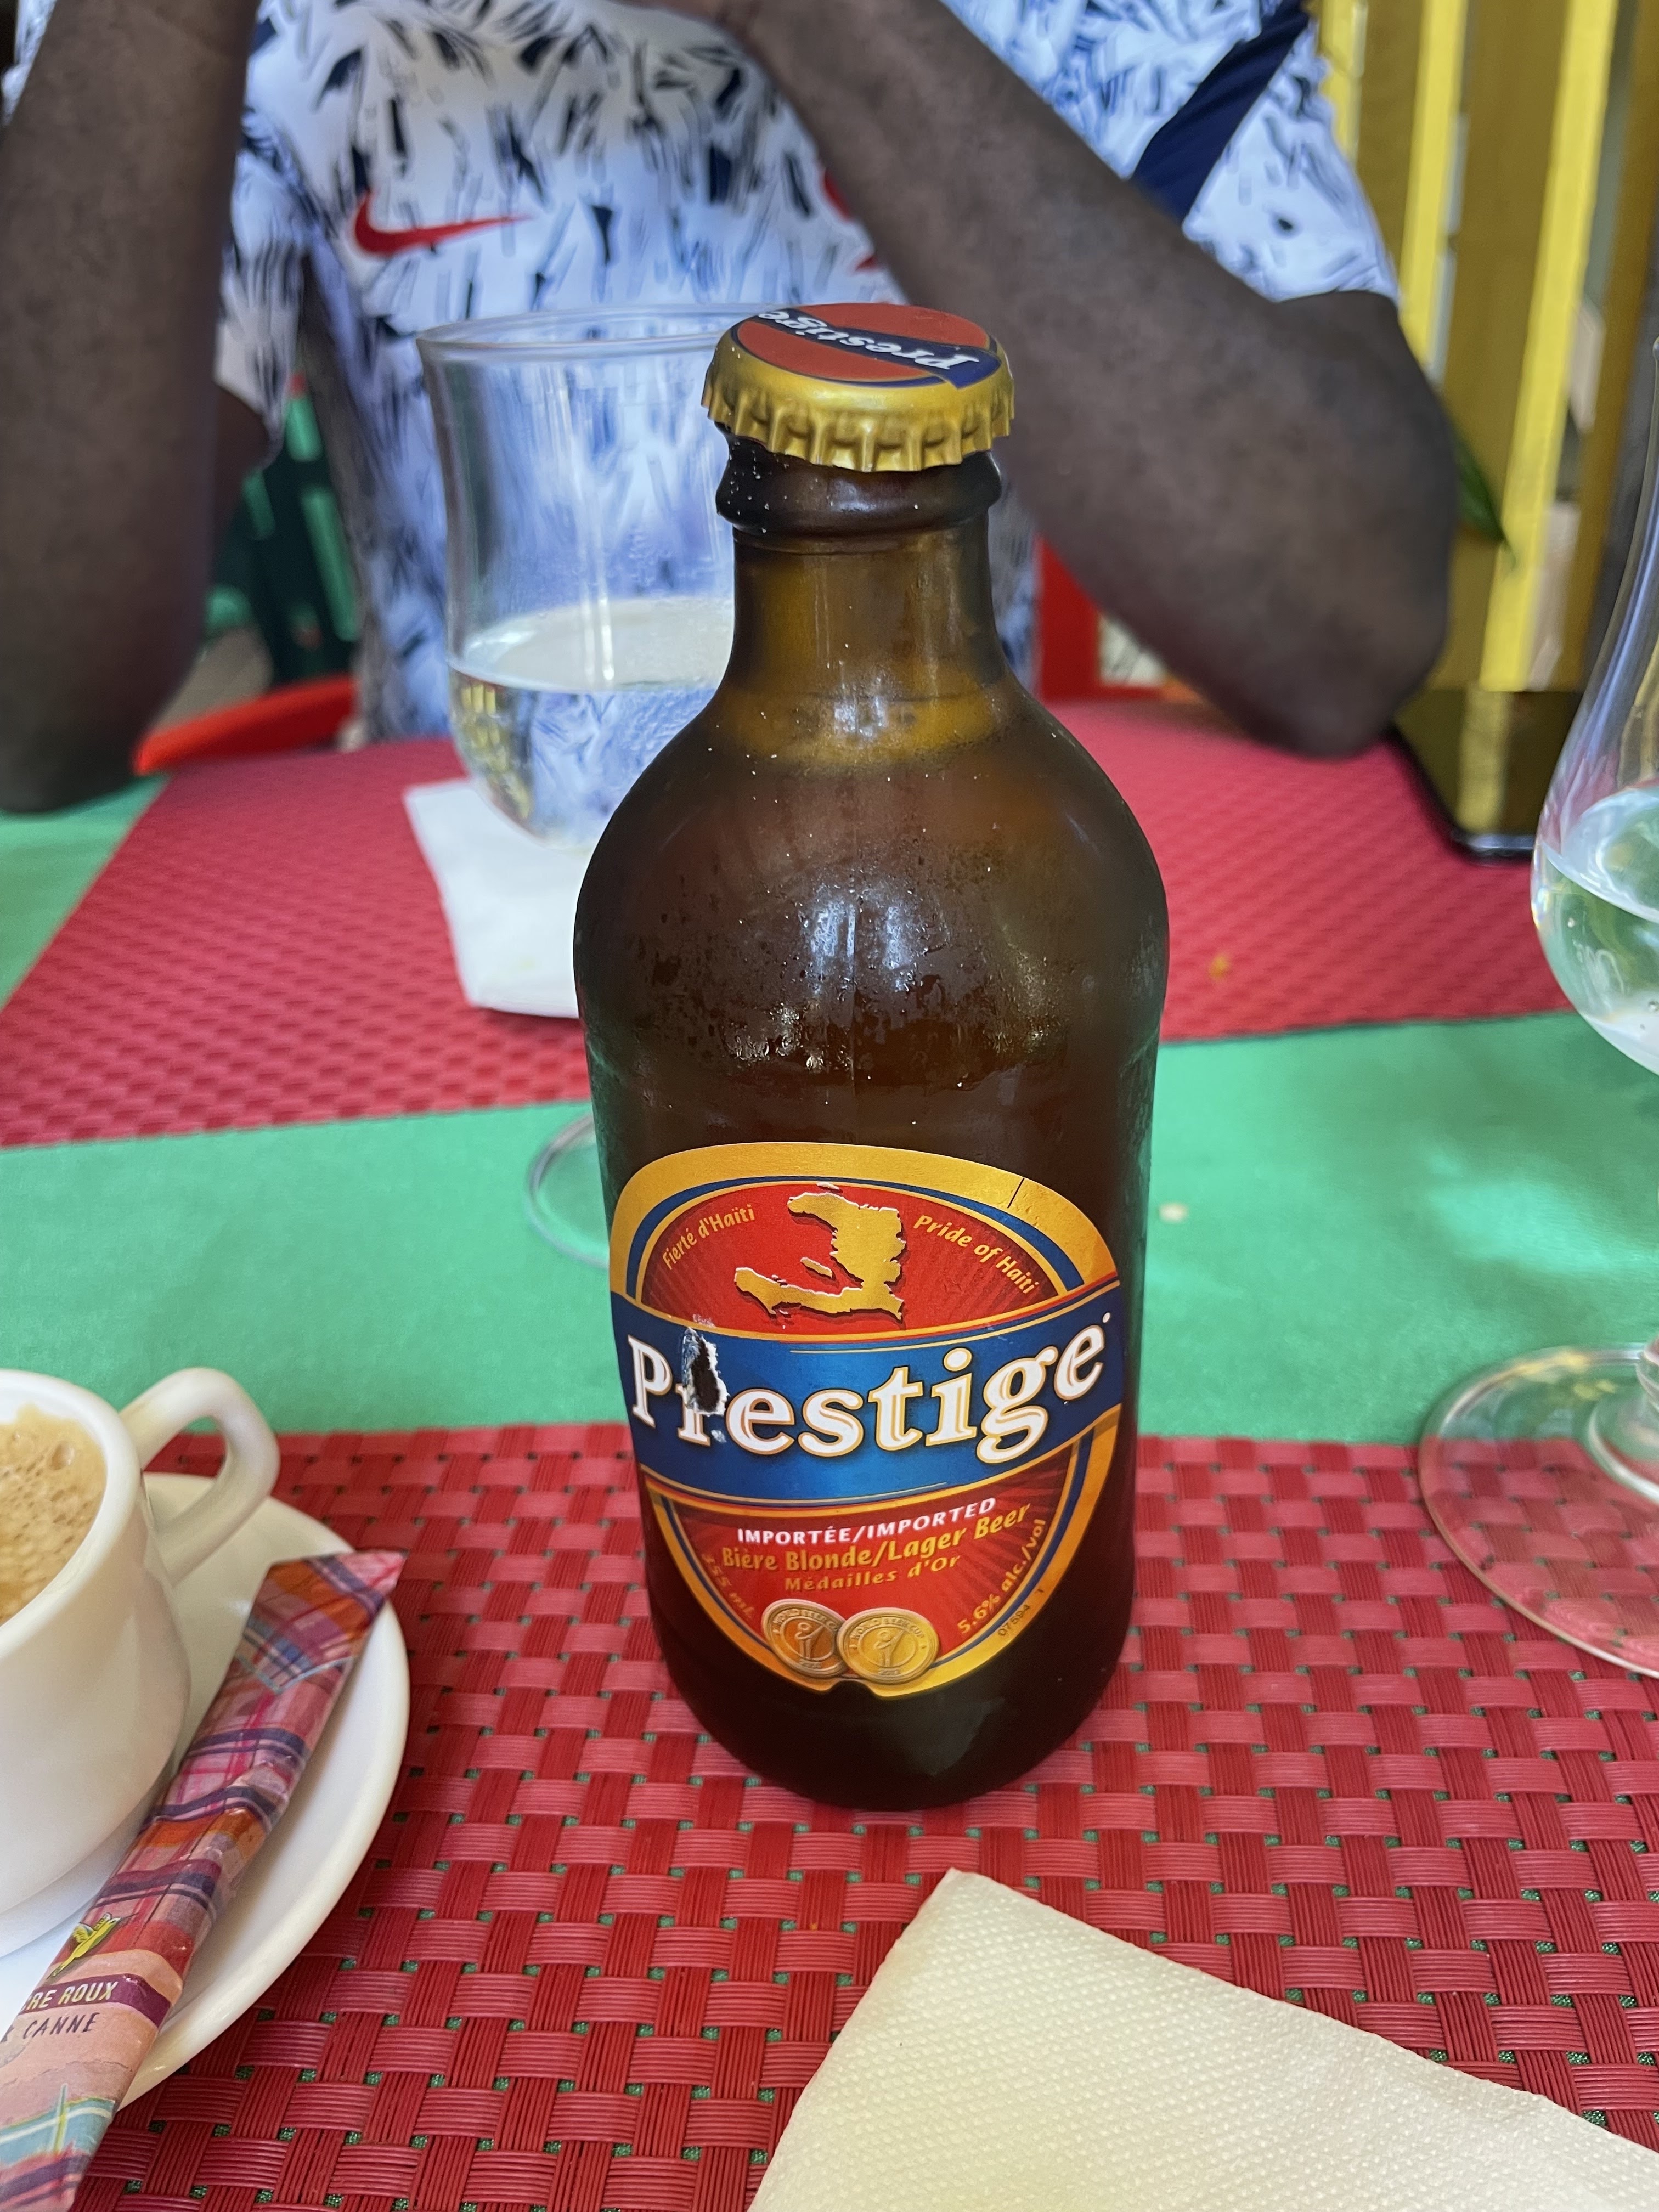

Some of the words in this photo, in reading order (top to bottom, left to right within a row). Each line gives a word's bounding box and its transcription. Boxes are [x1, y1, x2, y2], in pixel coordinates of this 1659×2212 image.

[758, 311, 979, 370] Prestige
[662, 1228, 697, 1270] Fierté
[698, 1204, 755, 1238] d'Haïti
[913, 1209, 973, 1248] Pride
[973, 1244, 1003, 1263] of
[995, 1256, 1040, 1294] Haiti
[722, 1547, 778, 1571] Bière
[785, 1527, 967, 1571] Blonde/Lager
[973, 1503, 1031, 1540] Beer
[737, 1497, 997, 1545] IMPORTÉE/IMPORTED
[785, 1570, 898, 1592] Médailles
[907, 1555, 960, 1578] d'Or
[957, 1593, 1001, 1634] 5.6%
[22, 1989, 58, 2011] RE
[57, 1981, 119, 2005] ROUX
[22, 2012, 100, 2039] CANNE
